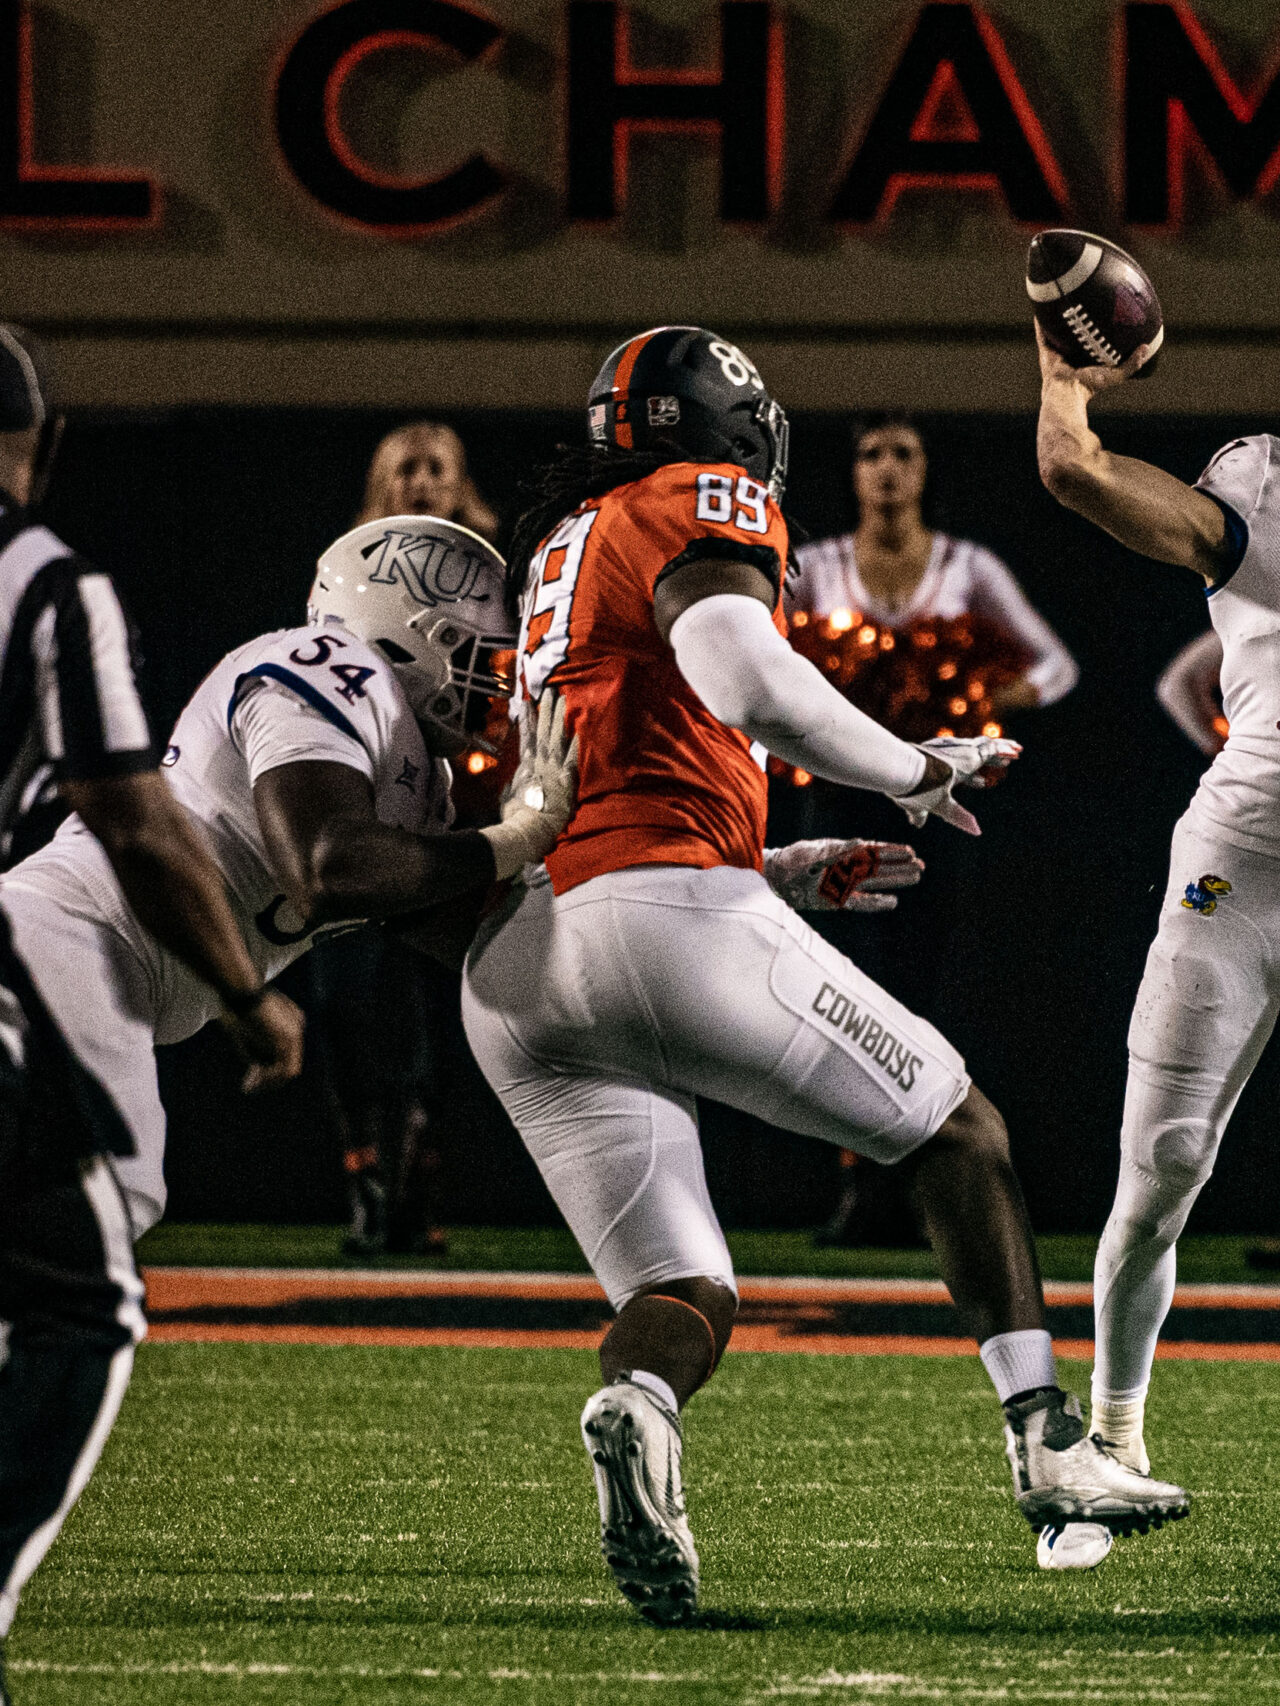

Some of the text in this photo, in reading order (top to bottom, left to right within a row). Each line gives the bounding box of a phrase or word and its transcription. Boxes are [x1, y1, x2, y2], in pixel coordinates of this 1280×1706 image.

[696, 472, 770, 536] 89
[369, 530, 490, 607] KU
[288, 634, 377, 707] 54
[811, 981, 924, 1093] COWBOYS
